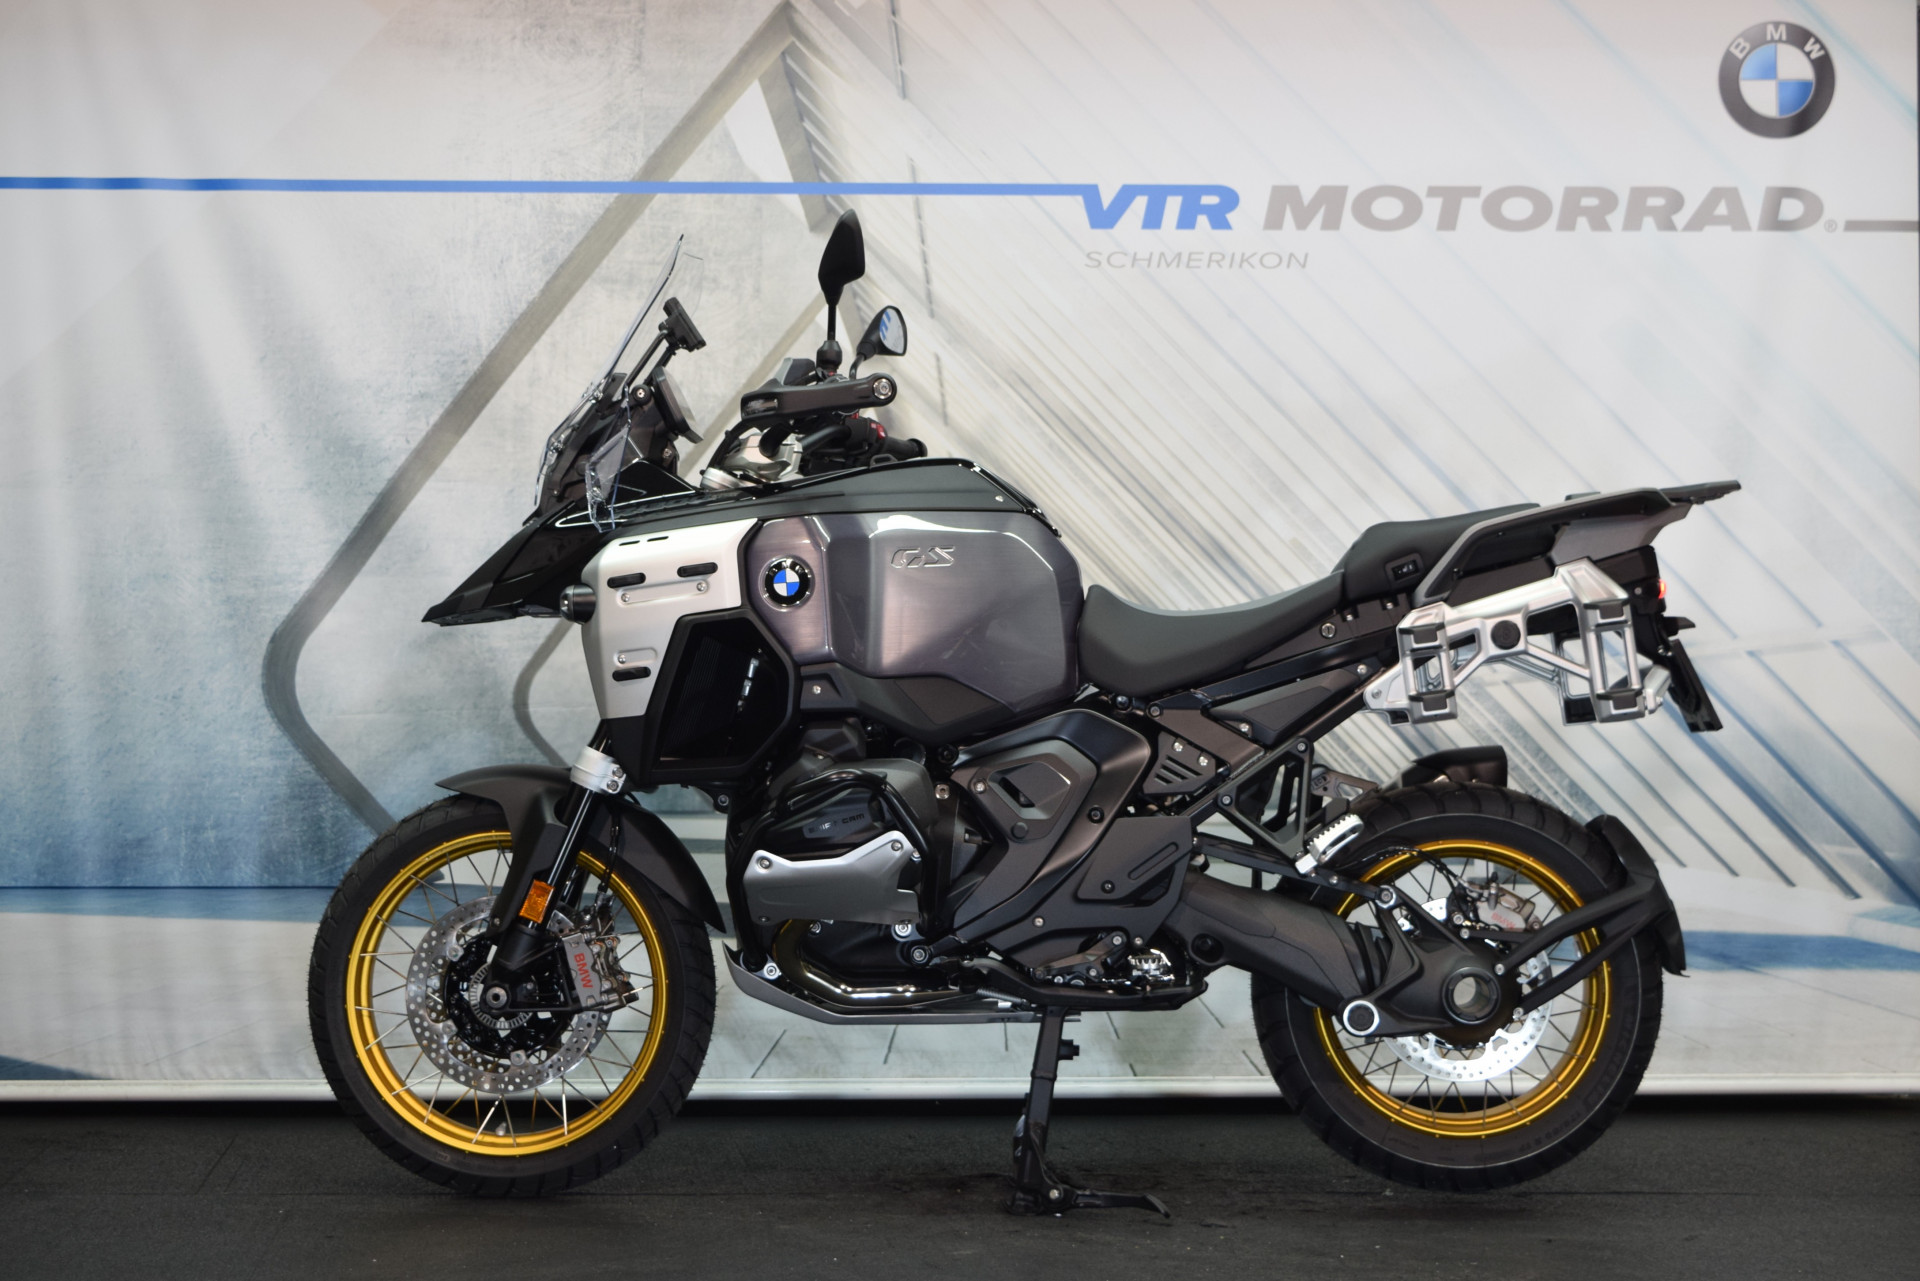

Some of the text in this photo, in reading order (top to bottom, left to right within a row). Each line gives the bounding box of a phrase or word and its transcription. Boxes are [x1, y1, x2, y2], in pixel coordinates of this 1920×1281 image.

[1729, 23, 1825, 60] BMW
[1083, 184, 1240, 230] VTR
[1085, 251, 1309, 270] SCHMERIKON
[890, 546, 956, 569] GS
[841, 812, 865, 824] CAM
[574, 953, 593, 988] BMW
